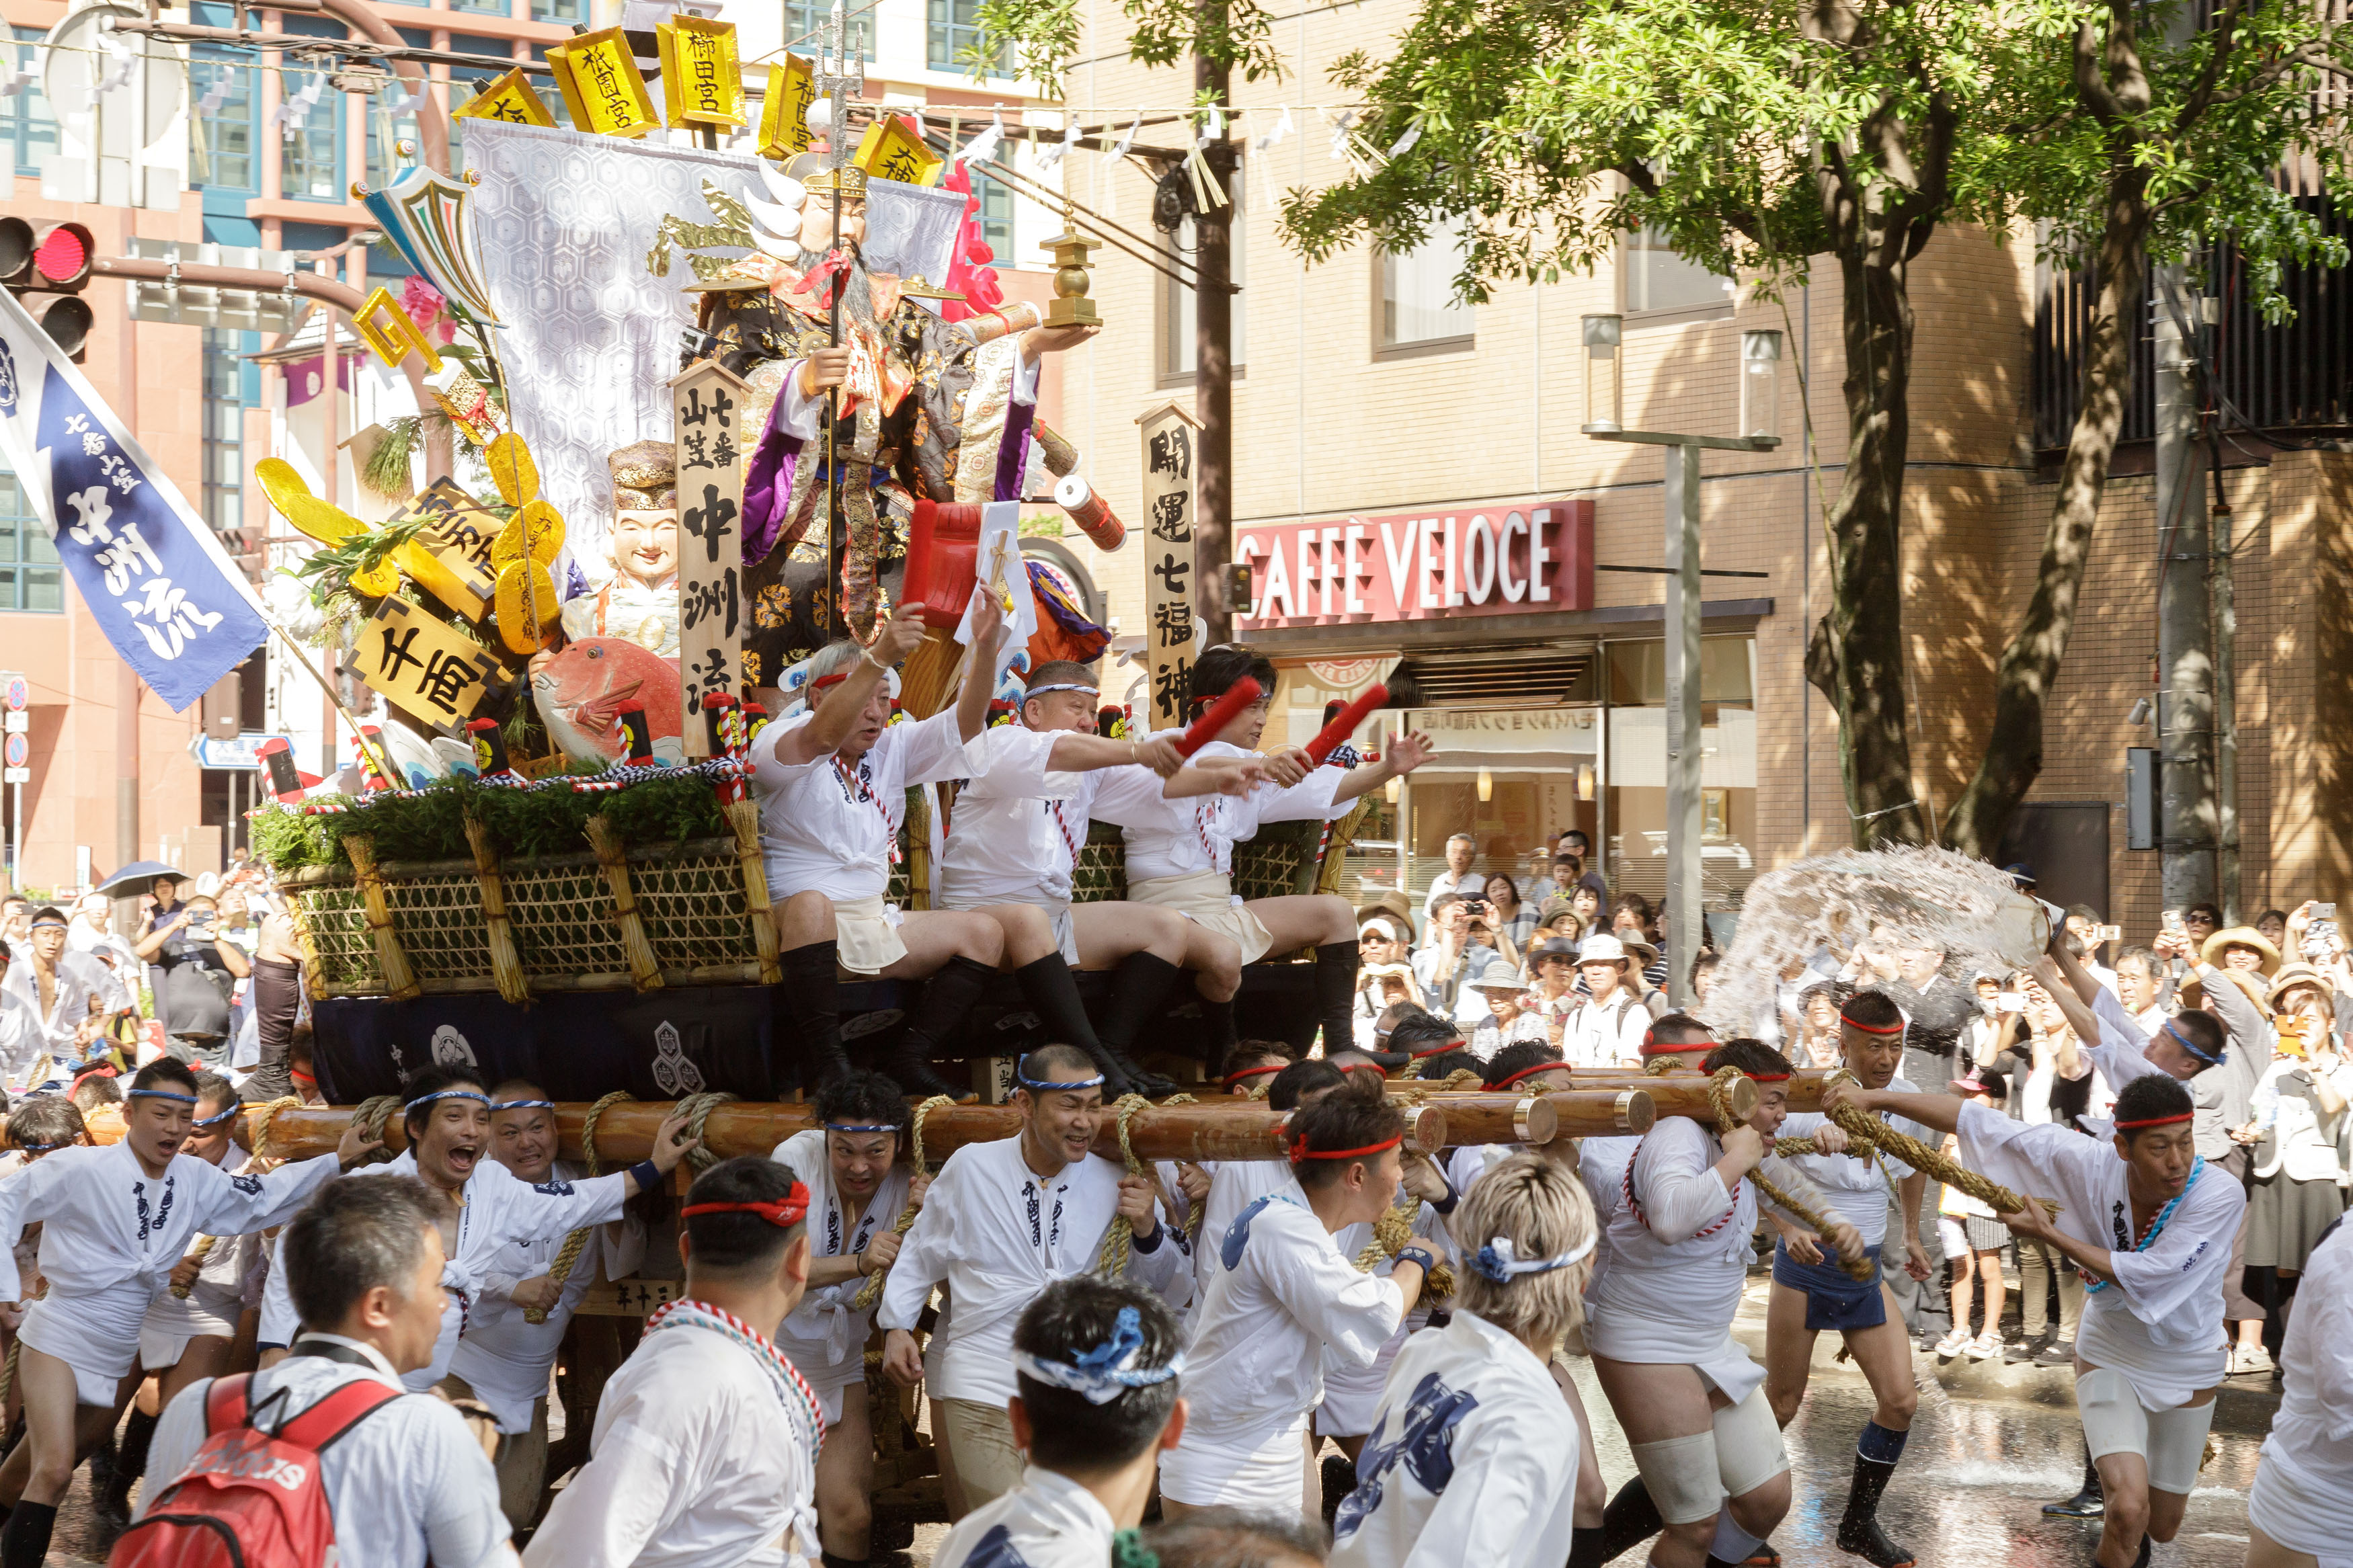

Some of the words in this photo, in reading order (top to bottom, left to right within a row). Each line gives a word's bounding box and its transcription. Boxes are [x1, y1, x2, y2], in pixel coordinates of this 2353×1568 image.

[582, 45, 632, 129] 祇園宮
[686, 30, 720, 113] 櫛田宮
[65, 413, 142, 495] 七番山笠
[681, 387, 715, 470] 山笠
[709, 387, 740, 469] 七番
[66, 485, 224, 661] 中洲流
[1149, 424, 1193, 728] 開運七福神
[1234, 515, 1365, 621] CAFFÈ
[1380, 508, 1552, 610] VELOCE
[379, 626, 481, 715] 千両
